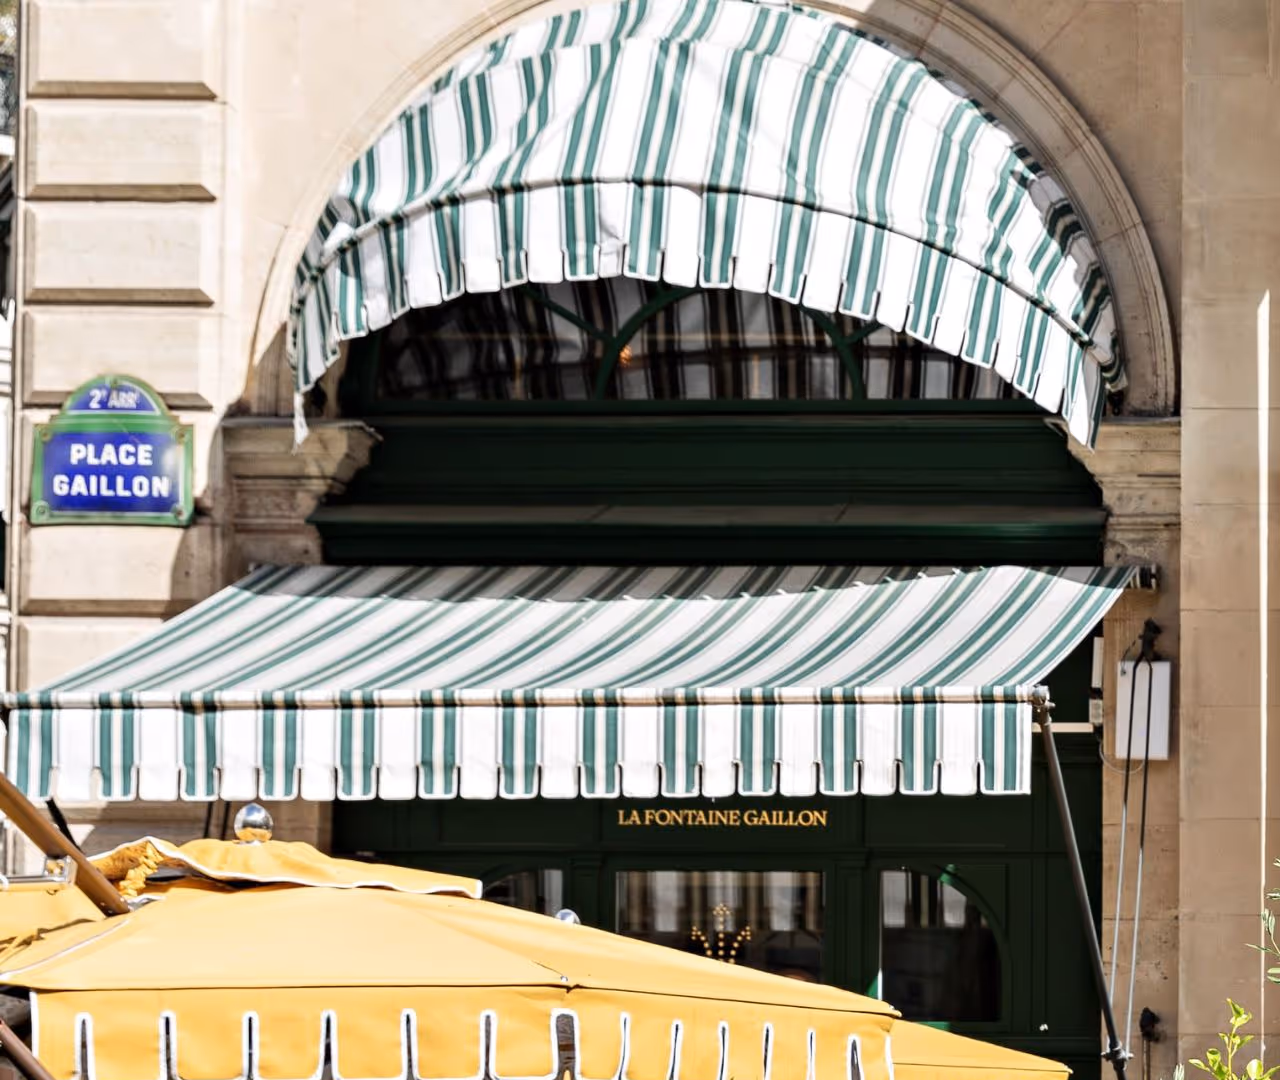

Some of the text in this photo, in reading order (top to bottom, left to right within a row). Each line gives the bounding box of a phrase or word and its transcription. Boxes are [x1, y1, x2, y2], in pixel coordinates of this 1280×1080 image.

[69, 443, 154, 466] PLACE
[52, 474, 171, 498] GAILLON
[617, 809, 828, 827] LA FONTAINE GAILLON
